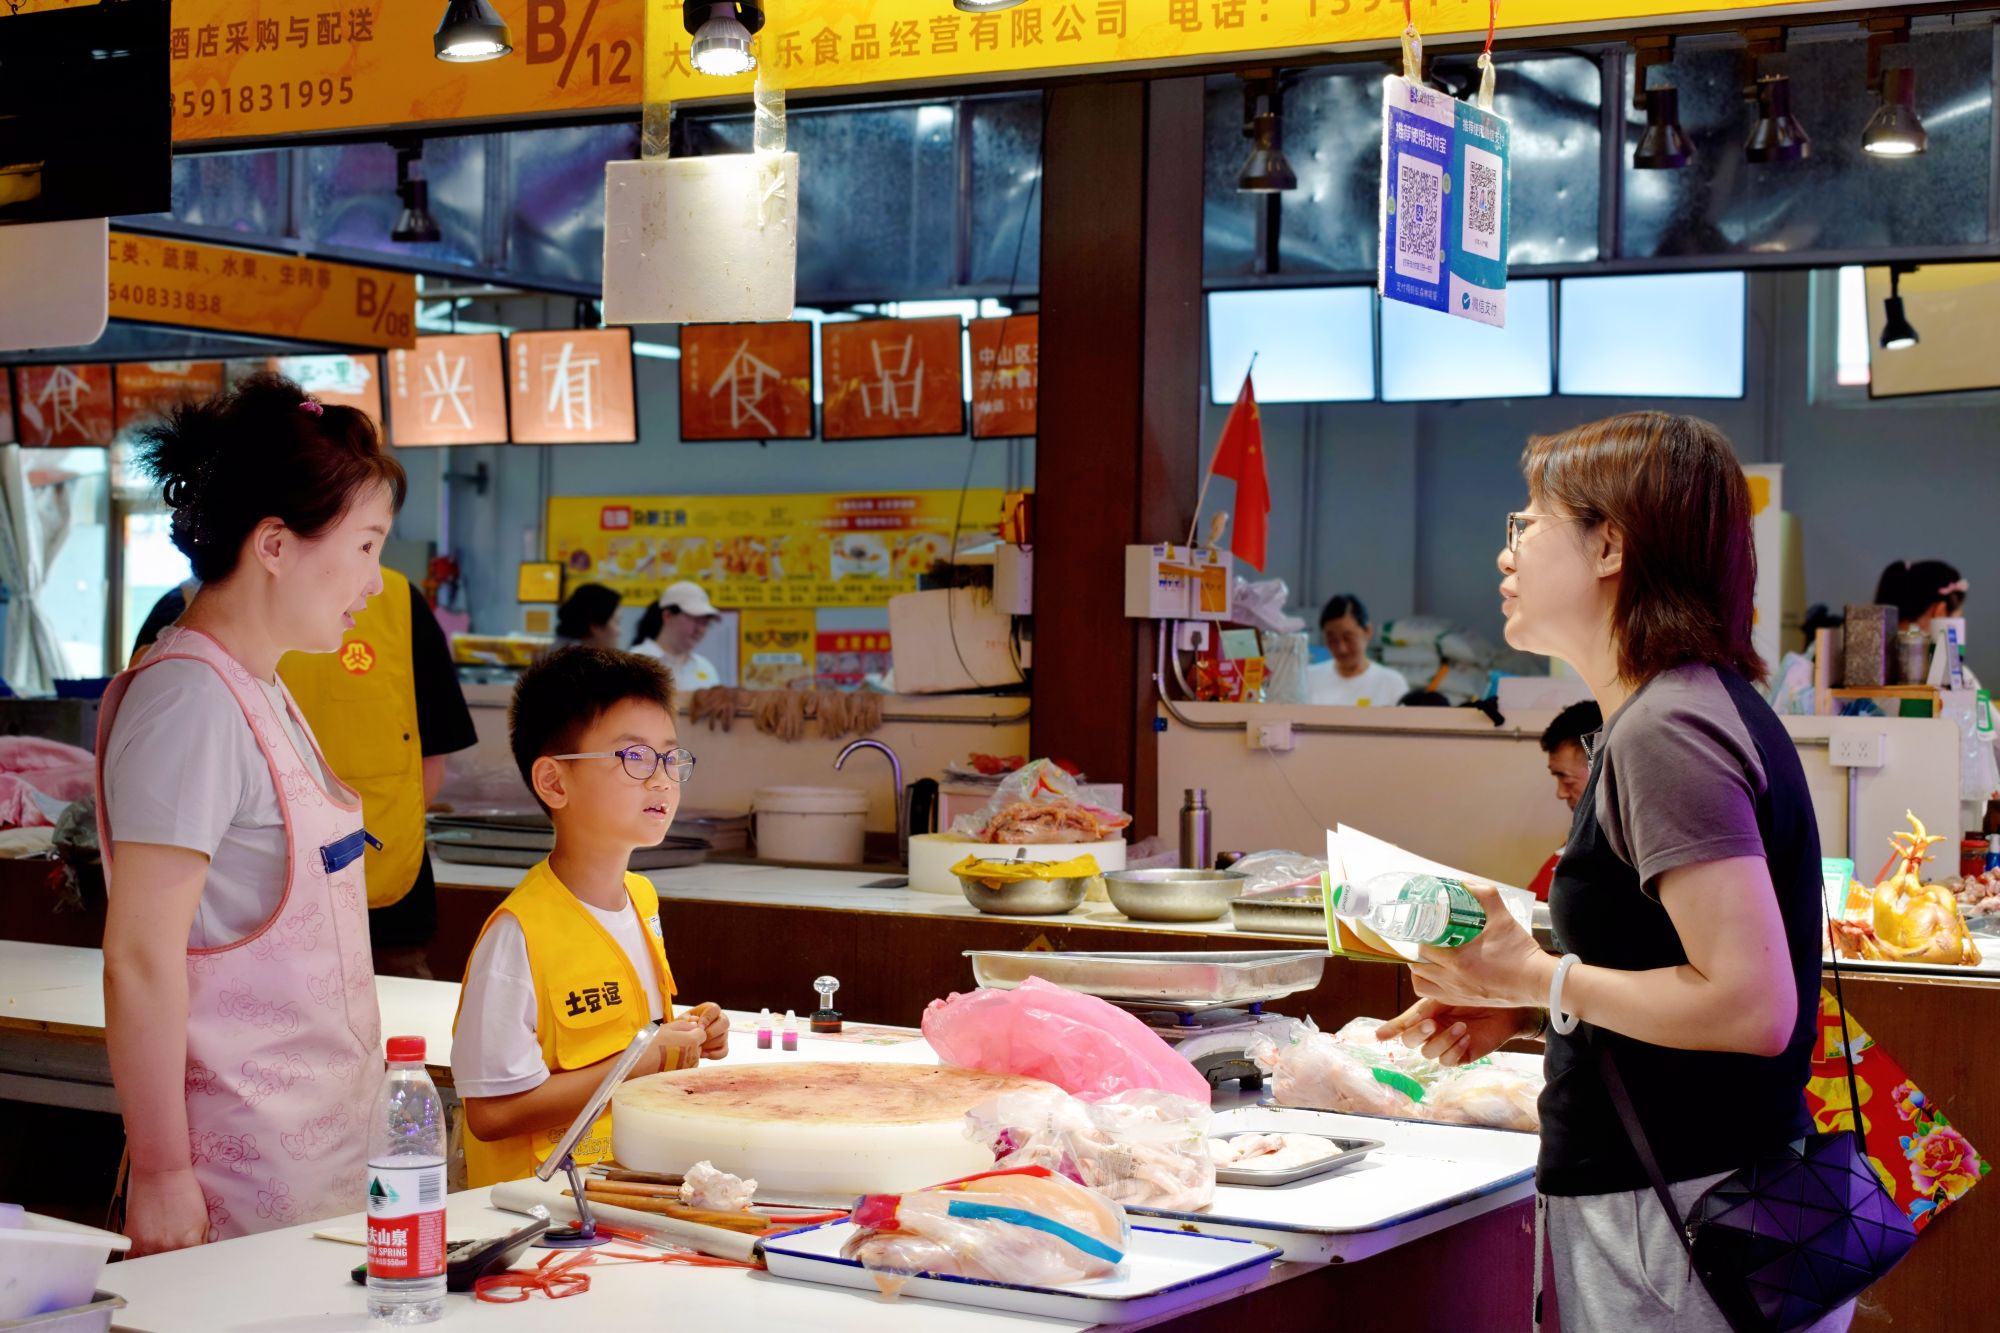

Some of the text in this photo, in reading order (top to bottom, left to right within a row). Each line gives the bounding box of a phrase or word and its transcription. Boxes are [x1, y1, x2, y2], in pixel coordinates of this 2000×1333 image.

[170, 8, 374, 60] 酒店采购与配送
[525, 0, 632, 89] B/12
[662, 0, 1127, 79] 大乐食品经营有限公司
[1395, 121, 1447, 154] 推荐使用支付宝
[356, 276, 410, 338] B/08
[541, 341, 601, 431] 有
[709, 338, 783, 435] 食
[861, 334, 925, 420] 品
[565, 981, 623, 1017] 土豆逗
[379, 1247, 408, 1257] SPRING
